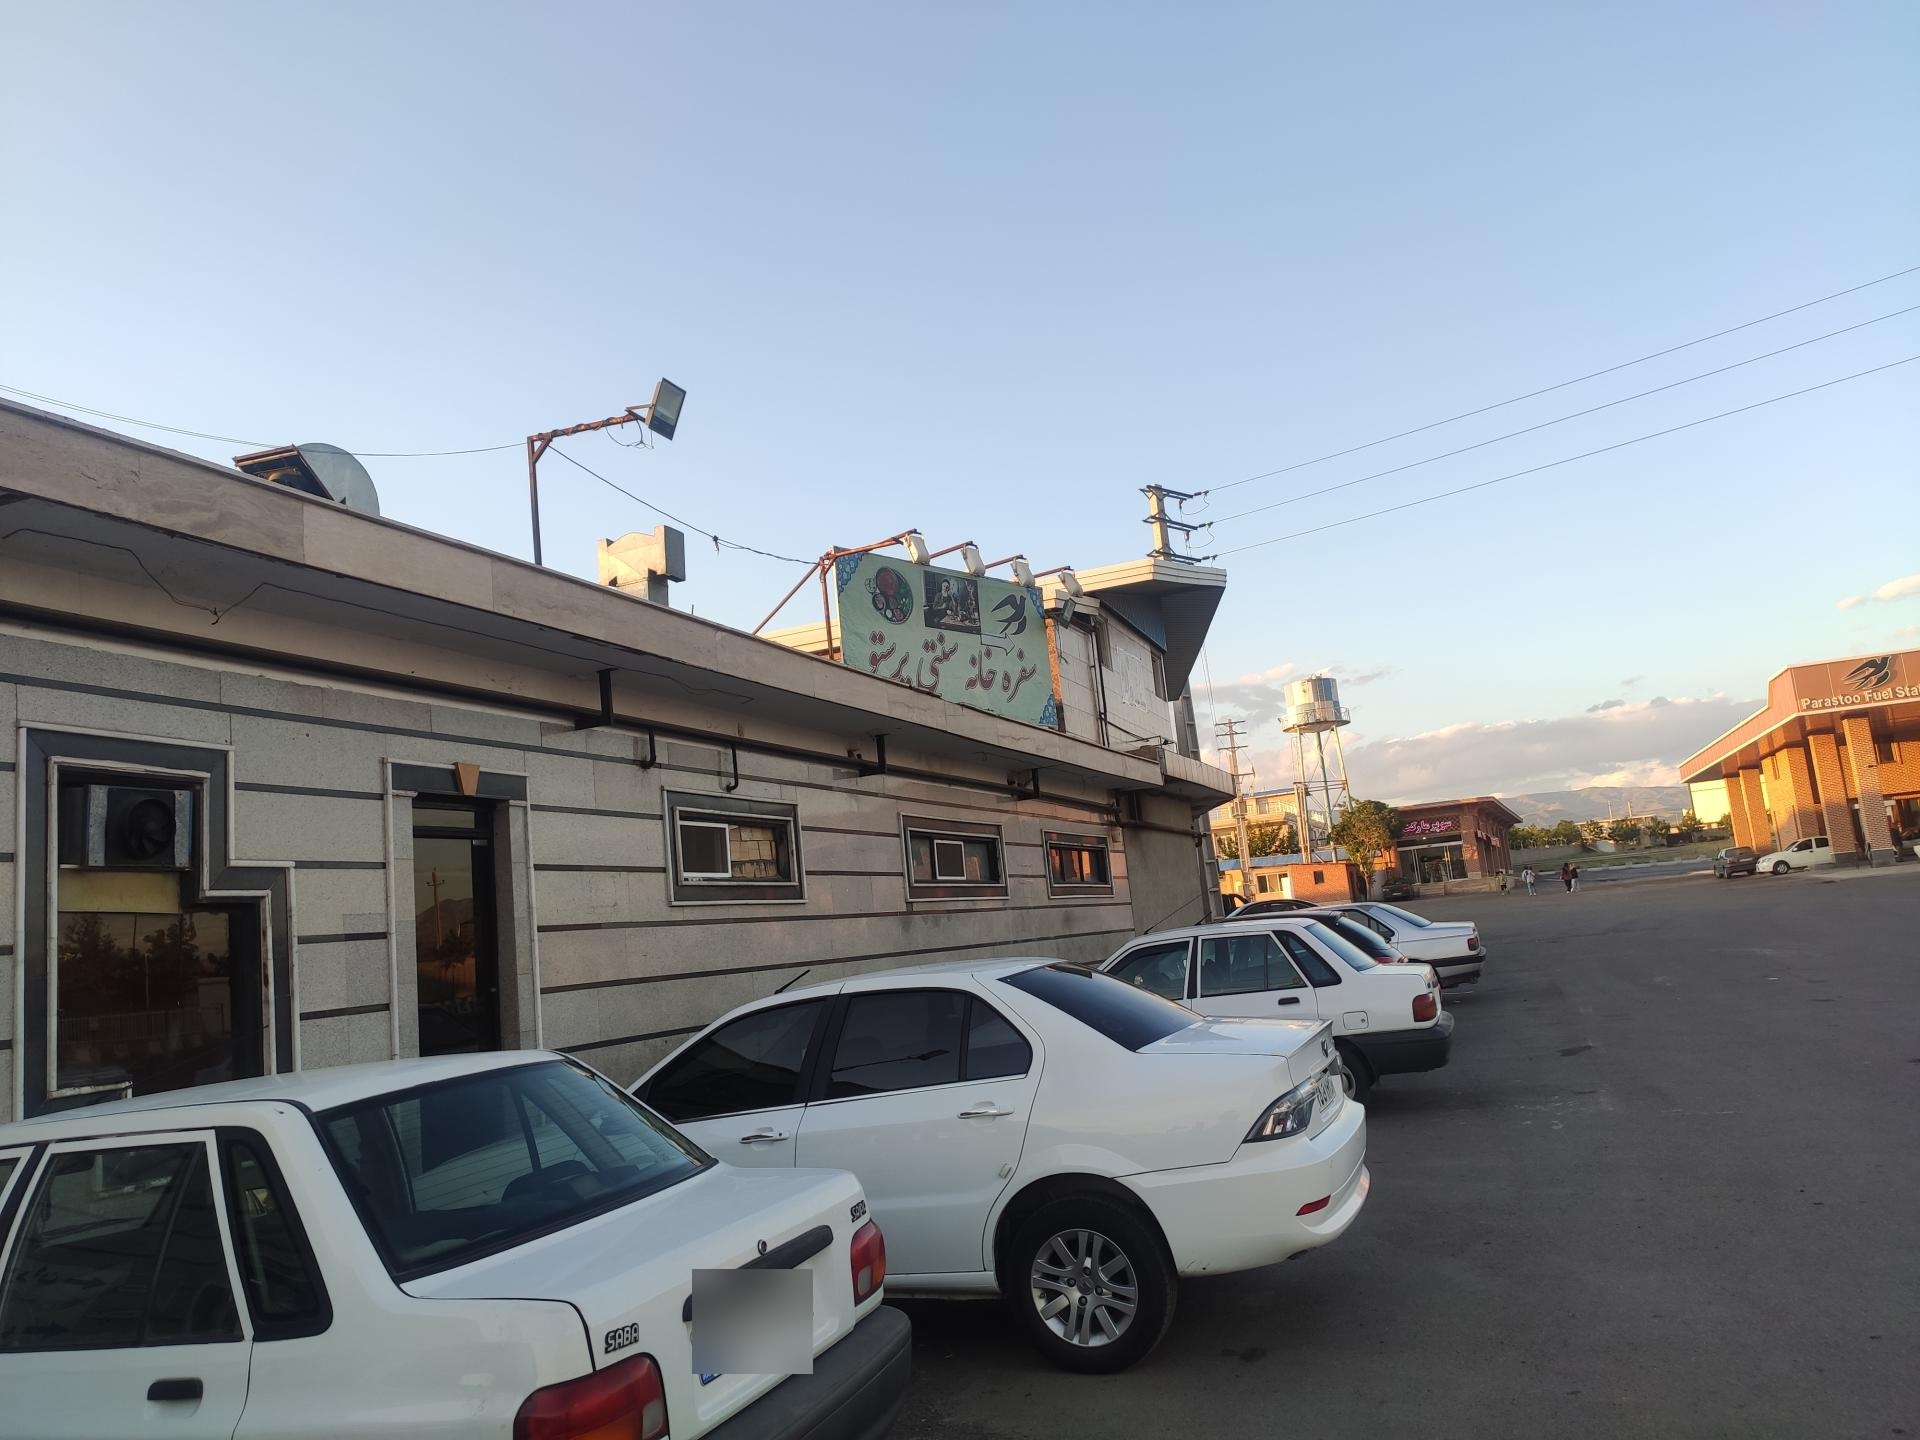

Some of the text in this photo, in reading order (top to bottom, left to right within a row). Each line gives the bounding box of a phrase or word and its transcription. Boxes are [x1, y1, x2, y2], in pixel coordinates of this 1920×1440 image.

[916, 632, 958, 692] سنتی
[1801, 694, 1861, 709] Parastoo
[1863, 688, 1893, 702] Fuel
[605, 1323, 639, 1354] SABA
